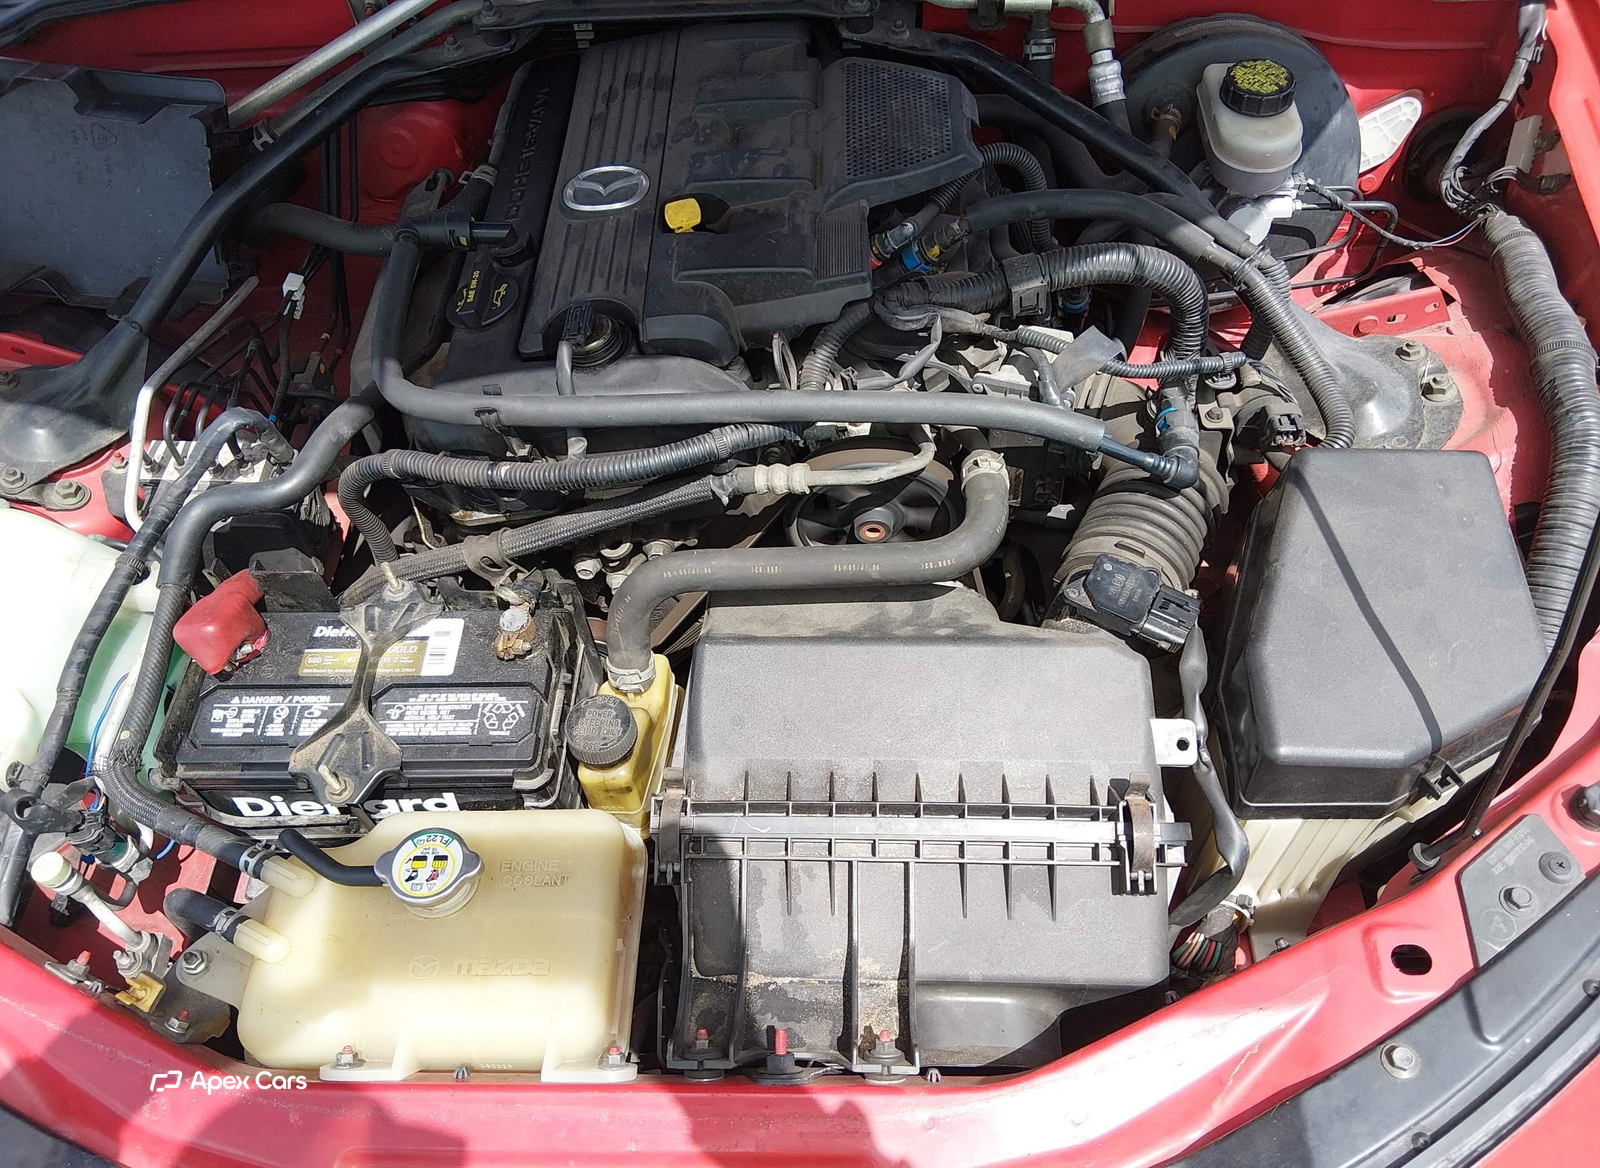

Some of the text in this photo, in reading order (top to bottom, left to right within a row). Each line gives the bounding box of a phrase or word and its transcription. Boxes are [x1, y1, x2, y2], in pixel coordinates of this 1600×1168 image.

[313, 625, 357, 637] DieH
[242, 696, 283, 704] DANGER
[293, 695, 331, 703] POISON
[597, 696, 619, 706] OPEN
[587, 709, 614, 718] POWER
[578, 718, 621, 727] STEERING
[573, 727, 622, 736] FLUID ONLY
[575, 737, 599, 750] CLOSE
[425, 834, 450, 845] FL22
[500, 859, 559, 872] ENGINE
[502, 874, 571, 887] COOLANT
